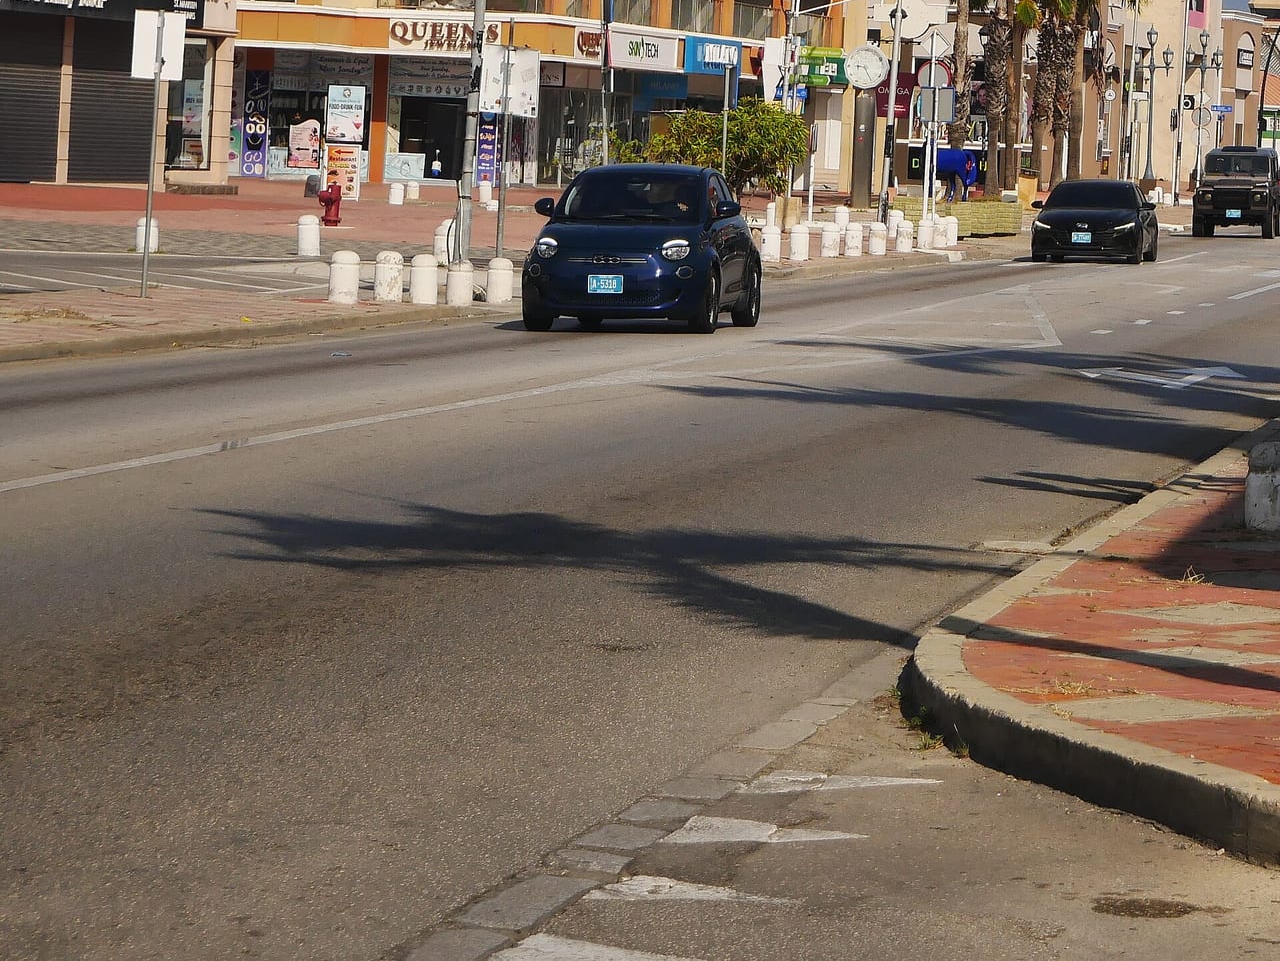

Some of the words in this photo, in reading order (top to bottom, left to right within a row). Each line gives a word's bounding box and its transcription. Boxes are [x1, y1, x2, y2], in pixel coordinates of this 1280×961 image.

[628, 40, 642, 57] SKIN
[645, 42, 659, 59] TECH
[878, 86, 910, 96] OMGA
[329, 155, 358, 163] Restaurant
